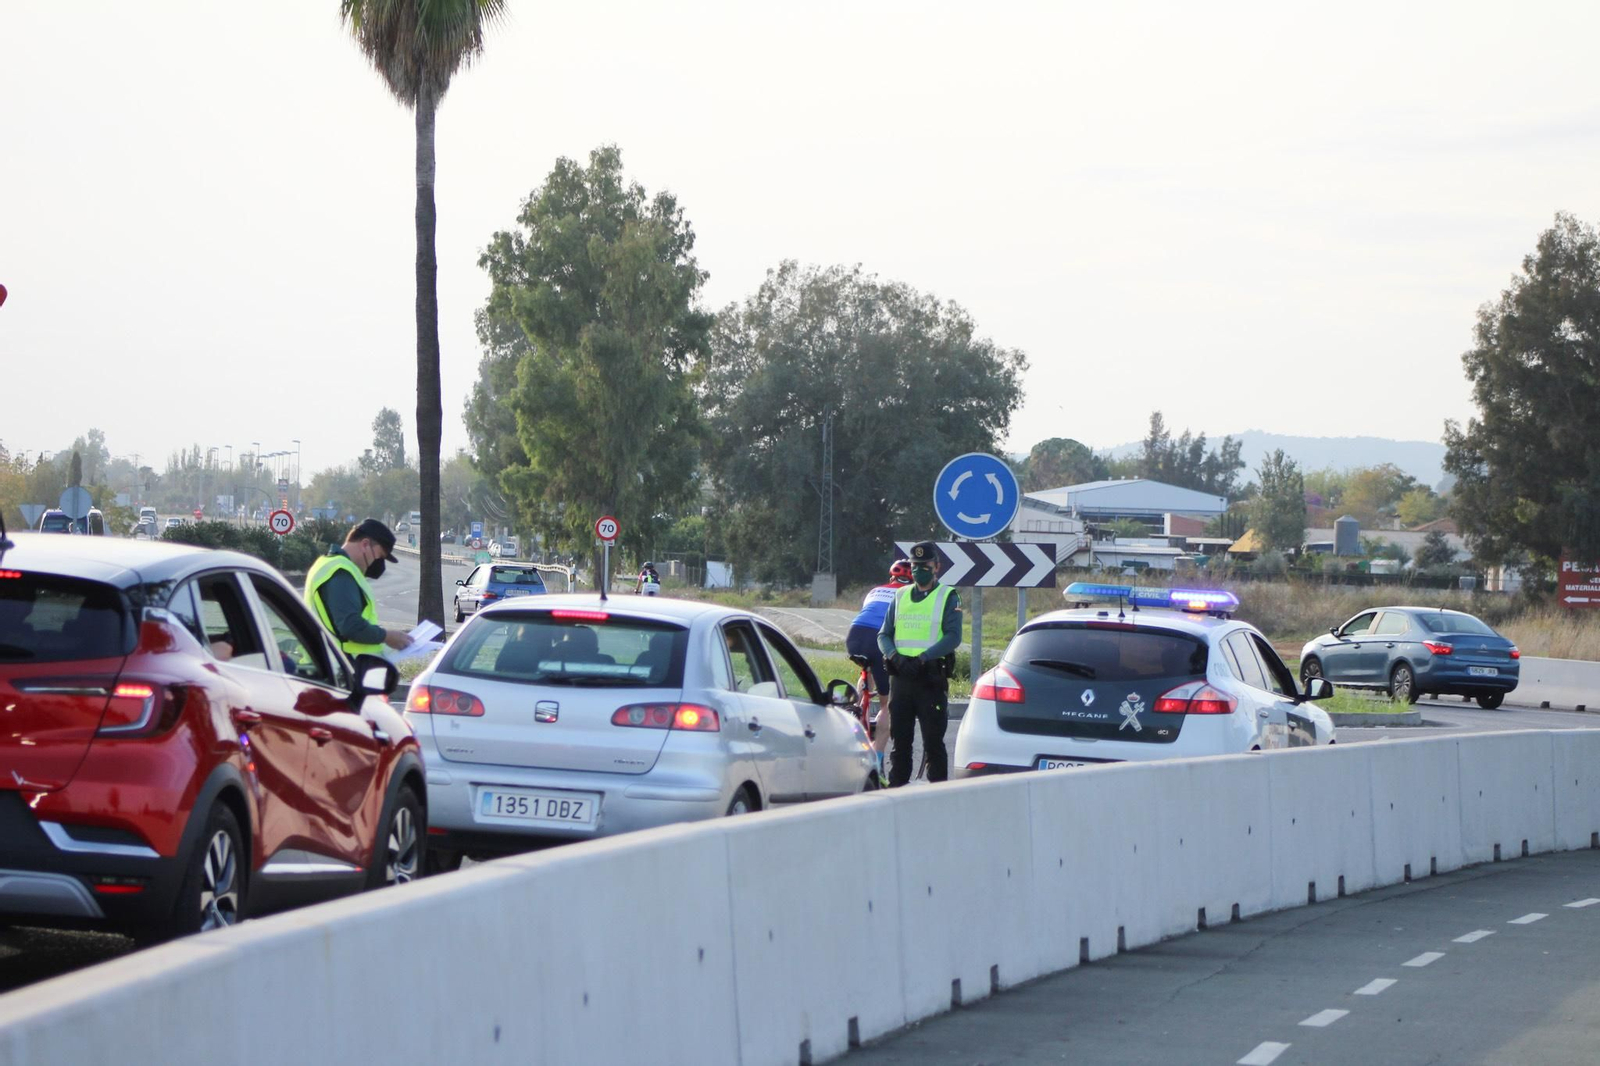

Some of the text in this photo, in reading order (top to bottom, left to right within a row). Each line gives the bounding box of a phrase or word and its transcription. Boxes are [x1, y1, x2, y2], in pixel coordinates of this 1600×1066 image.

[275, 518, 288, 527] 70
[601, 524, 615, 533] 70
[1565, 584, 1600, 592] MATERIAL
[903, 621, 921, 629] CIVIL
[1062, 711, 1109, 719] MEGANE
[496, 795, 584, 820] 1351 DBZ
